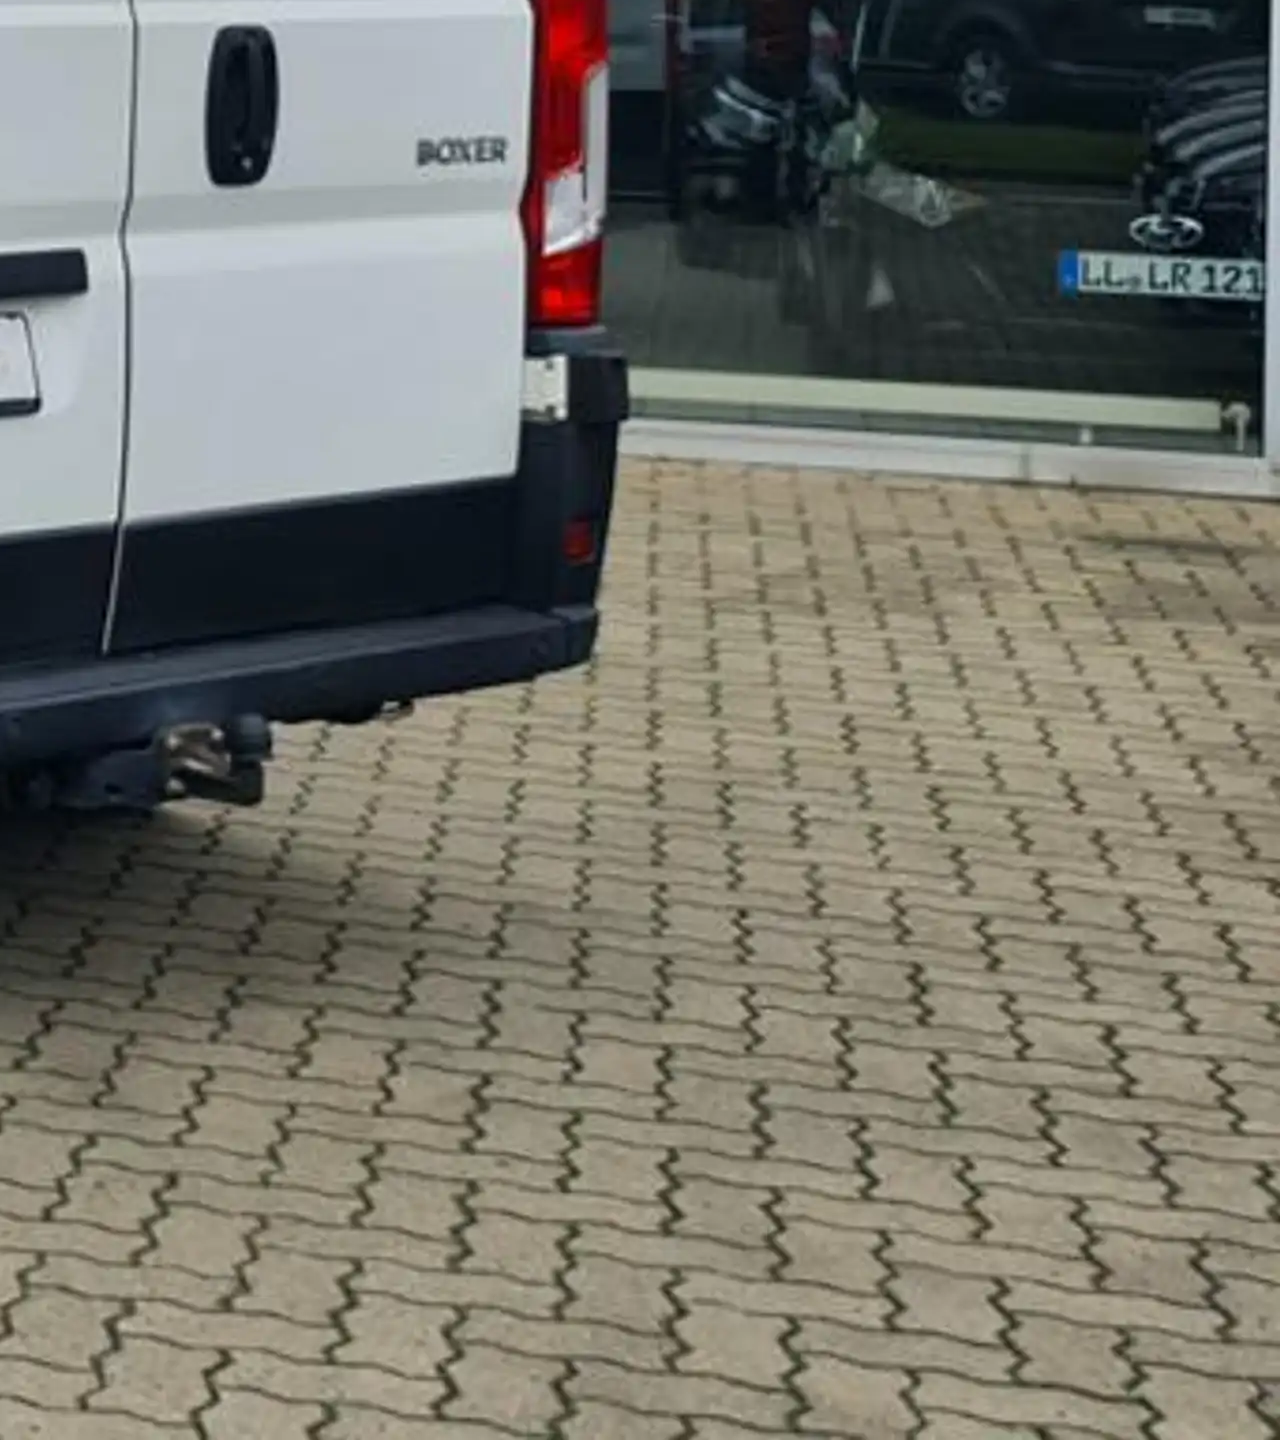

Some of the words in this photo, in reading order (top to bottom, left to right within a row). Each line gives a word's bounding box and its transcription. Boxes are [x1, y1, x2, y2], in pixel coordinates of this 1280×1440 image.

[416, 136, 509, 167] BOXER
[1081, 256, 1124, 288] LL
[1148, 261, 1192, 293] LR
